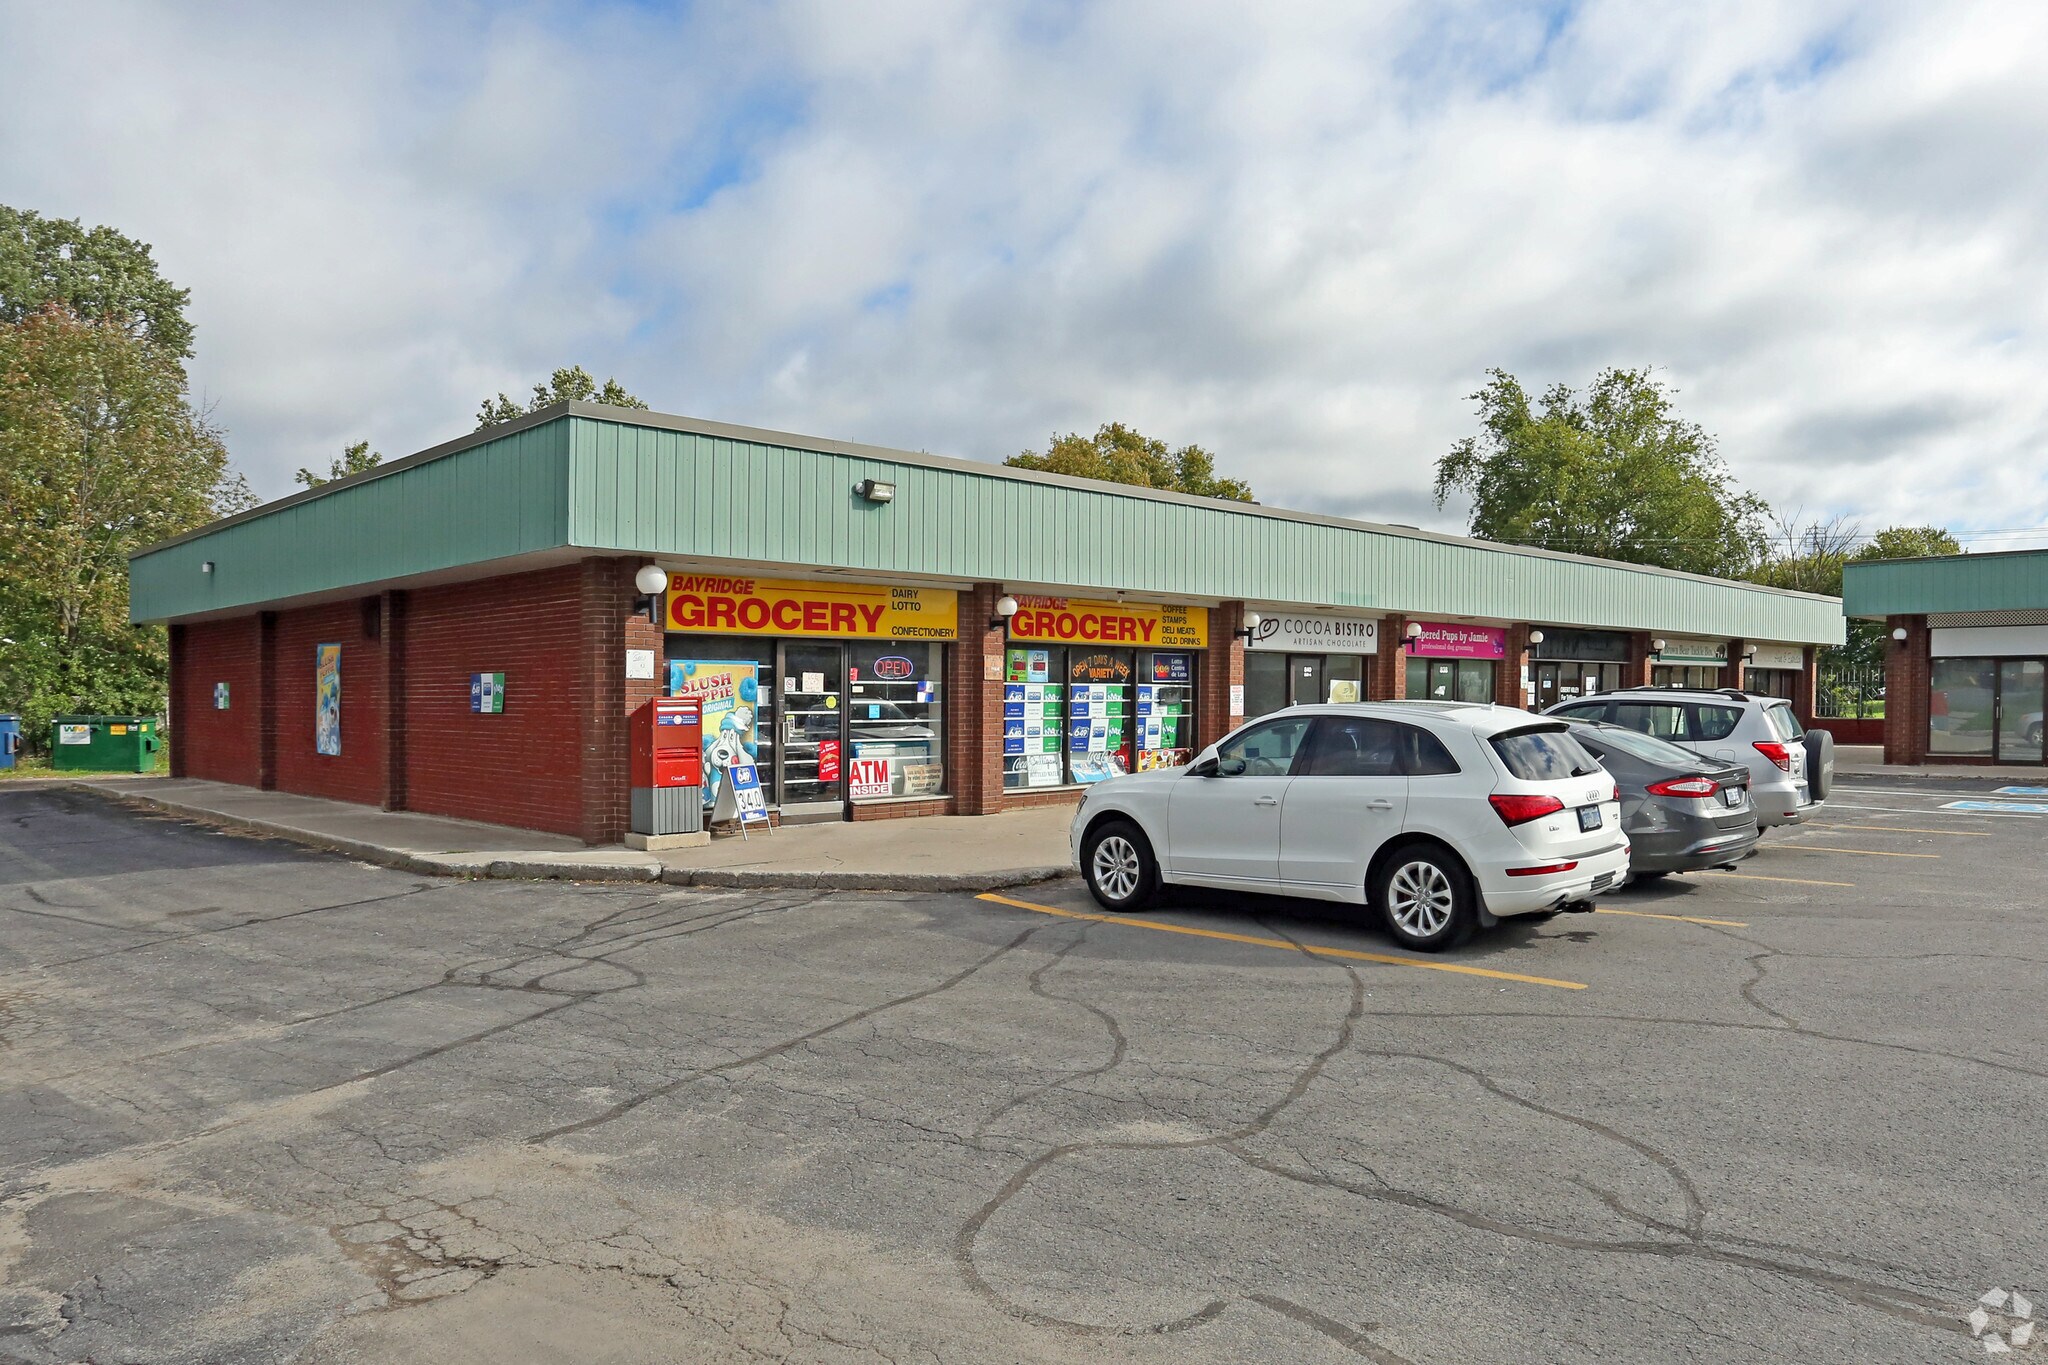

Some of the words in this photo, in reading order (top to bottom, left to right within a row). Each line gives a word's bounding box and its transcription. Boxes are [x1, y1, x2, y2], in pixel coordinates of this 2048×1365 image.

[671, 576, 755, 595] BAYRIDGE
[891, 588, 919, 599] DAIRY
[891, 601, 922, 611] LOTTO
[1161, 605, 1188, 614] COFFEE
[671, 594, 886, 633] GROCERY
[1011, 610, 1157, 642] GROCERY
[1161, 616, 1188, 625] STAMPS
[891, 626, 955, 637] CONFECTIONERY
[1161, 626, 1175, 634] DELI
[1177, 627, 1196, 635] MEATS
[1284, 619, 1332, 635] COCOA
[1335, 622, 1374, 637] BISTRO
[1161, 637, 1178, 645] COLD
[1180, 637, 1201, 646] DRINKS
[1293, 638, 1323, 646] ARTISAN
[1327, 639, 1366, 648] CHOCOLATE
[1442, 630, 1458, 643] Pups
[1459, 631, 1467, 644] by
[1469, 632, 1489, 642] Jamie
[877, 660, 910, 675] OPEN
[1072, 660, 1088, 678] OPEN
[1088, 656, 1093, 667] 7
[1094, 654, 1108, 666] DAYS
[1109, 656, 1114, 667] A
[1114, 660, 1131, 679] WEEK
[1089, 667, 1115, 679] VARIETY
[680, 672, 732, 695] SLUSH
[702, 699, 733, 714] ORIGINAL
[850, 760, 888, 785] ATM
[850, 785, 889, 795] INSIDE
